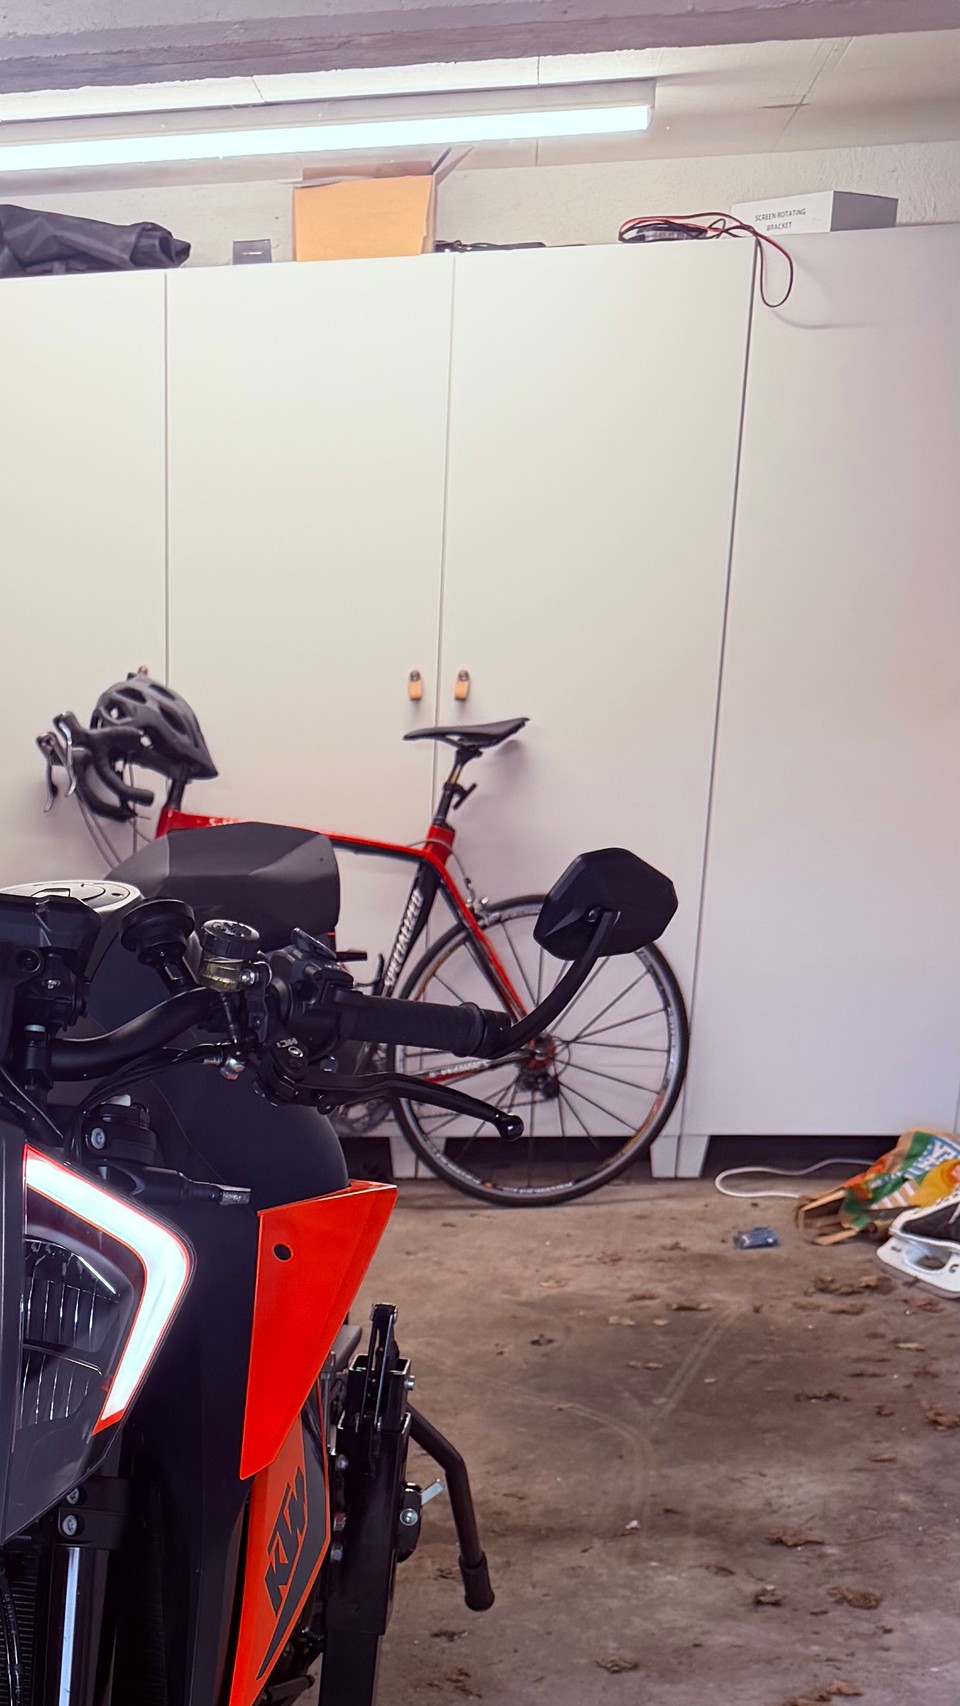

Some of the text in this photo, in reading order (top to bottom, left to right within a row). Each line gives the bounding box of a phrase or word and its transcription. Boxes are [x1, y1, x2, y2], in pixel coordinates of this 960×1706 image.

[755, 208, 806, 221] SCREEN ROTATING
[766, 221, 792, 231] BRACKET
[384, 888, 424, 986] SPECIALIZED
[265, 1466, 305, 1617] KTM
